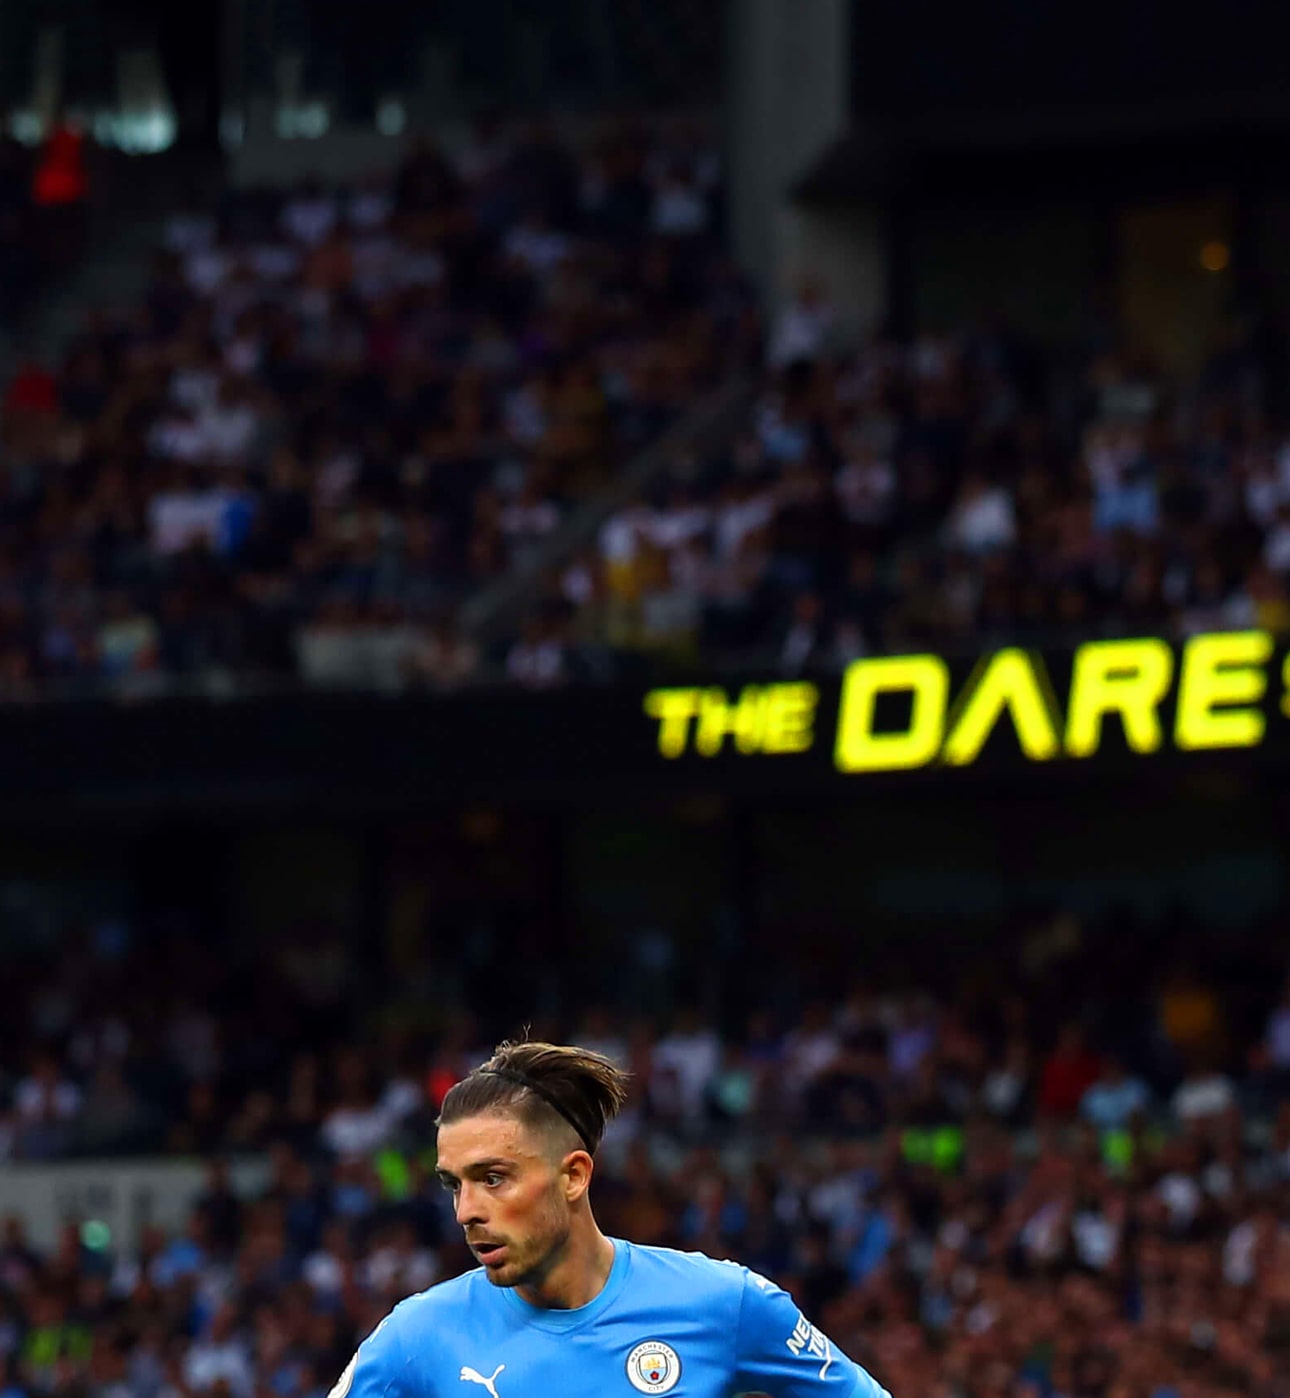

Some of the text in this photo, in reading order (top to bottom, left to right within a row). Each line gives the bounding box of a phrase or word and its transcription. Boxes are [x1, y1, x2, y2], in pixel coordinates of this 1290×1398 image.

[643, 630, 1290, 774] THE DARE
[631, 1343, 674, 1363] MANCHESTER
